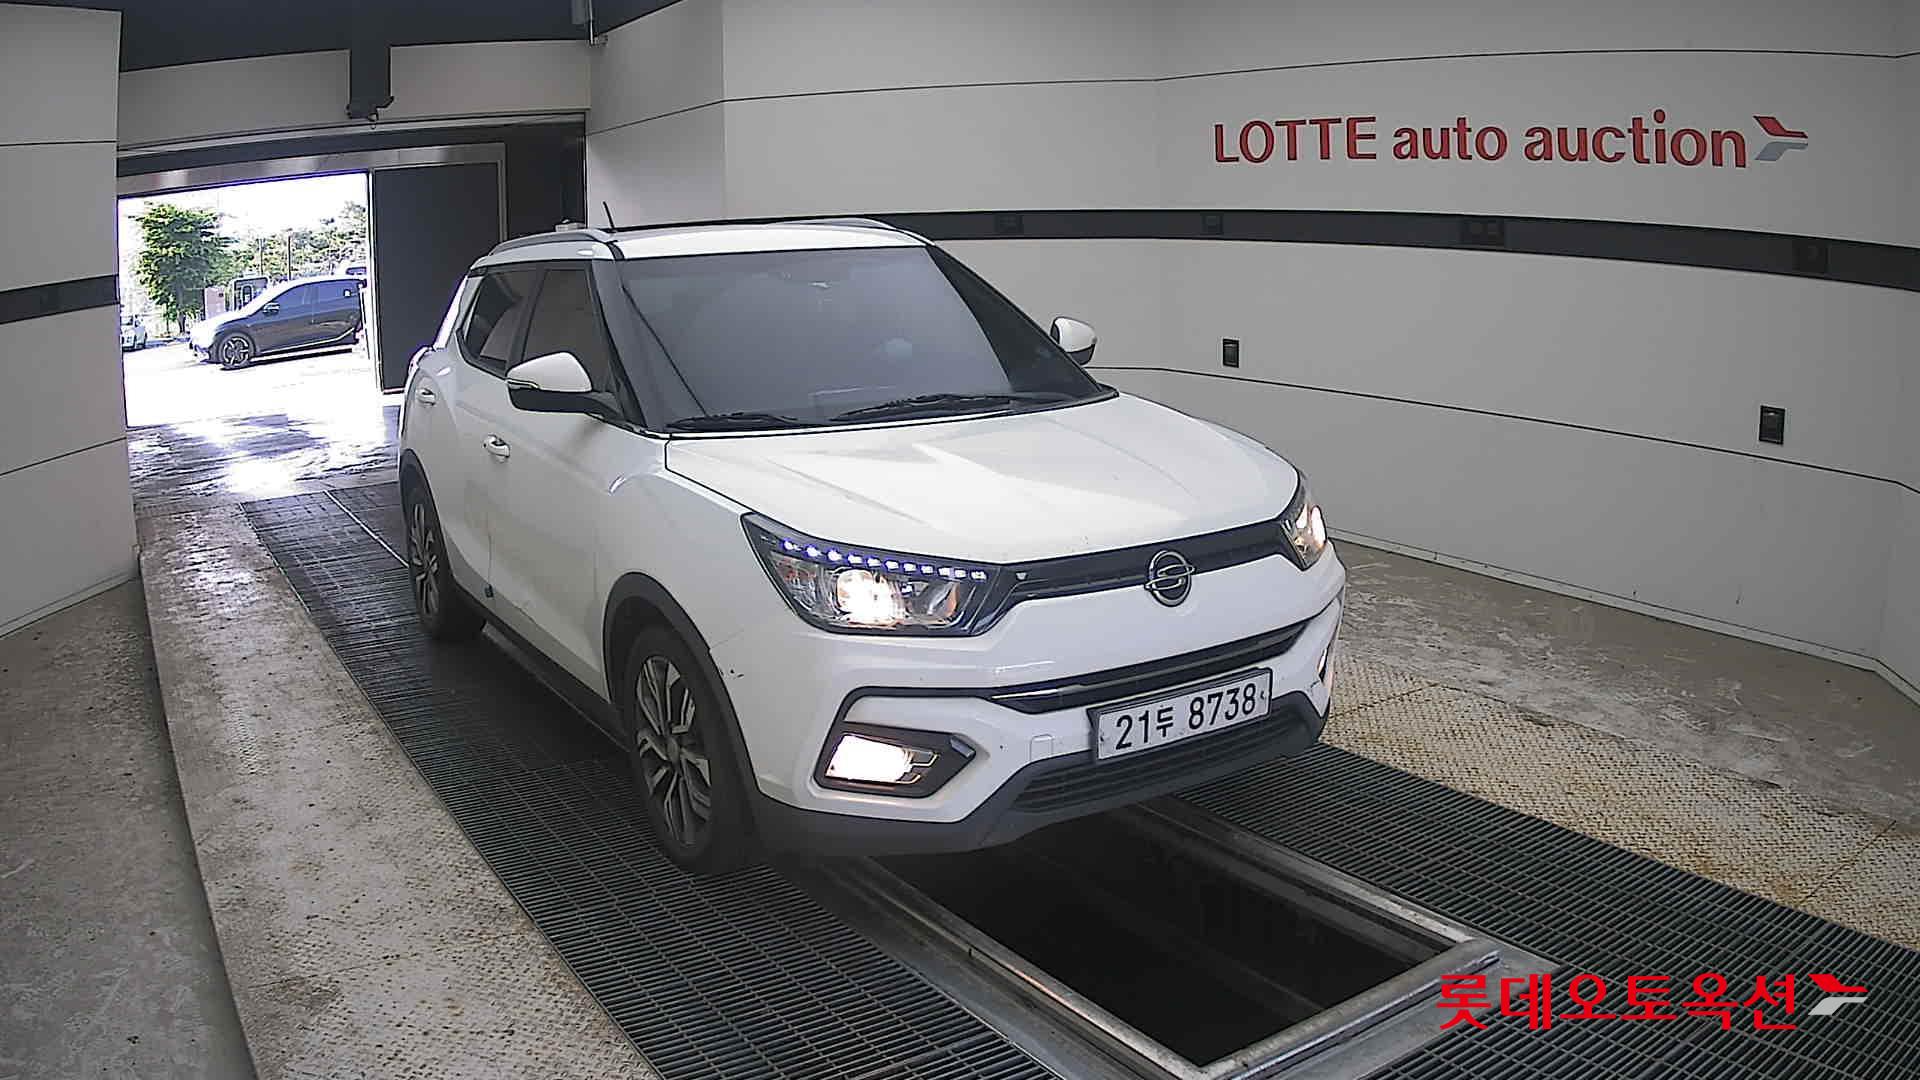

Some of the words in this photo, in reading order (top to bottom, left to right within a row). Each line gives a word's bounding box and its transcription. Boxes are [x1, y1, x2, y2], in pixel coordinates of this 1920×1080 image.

[1213, 115, 1378, 164] LOTTE
[1392, 115, 1509, 162] auto
[1523, 108, 1748, 169] auction
[1115, 705, 1175, 750] 21두
[1187, 682, 1257, 731] 8738
